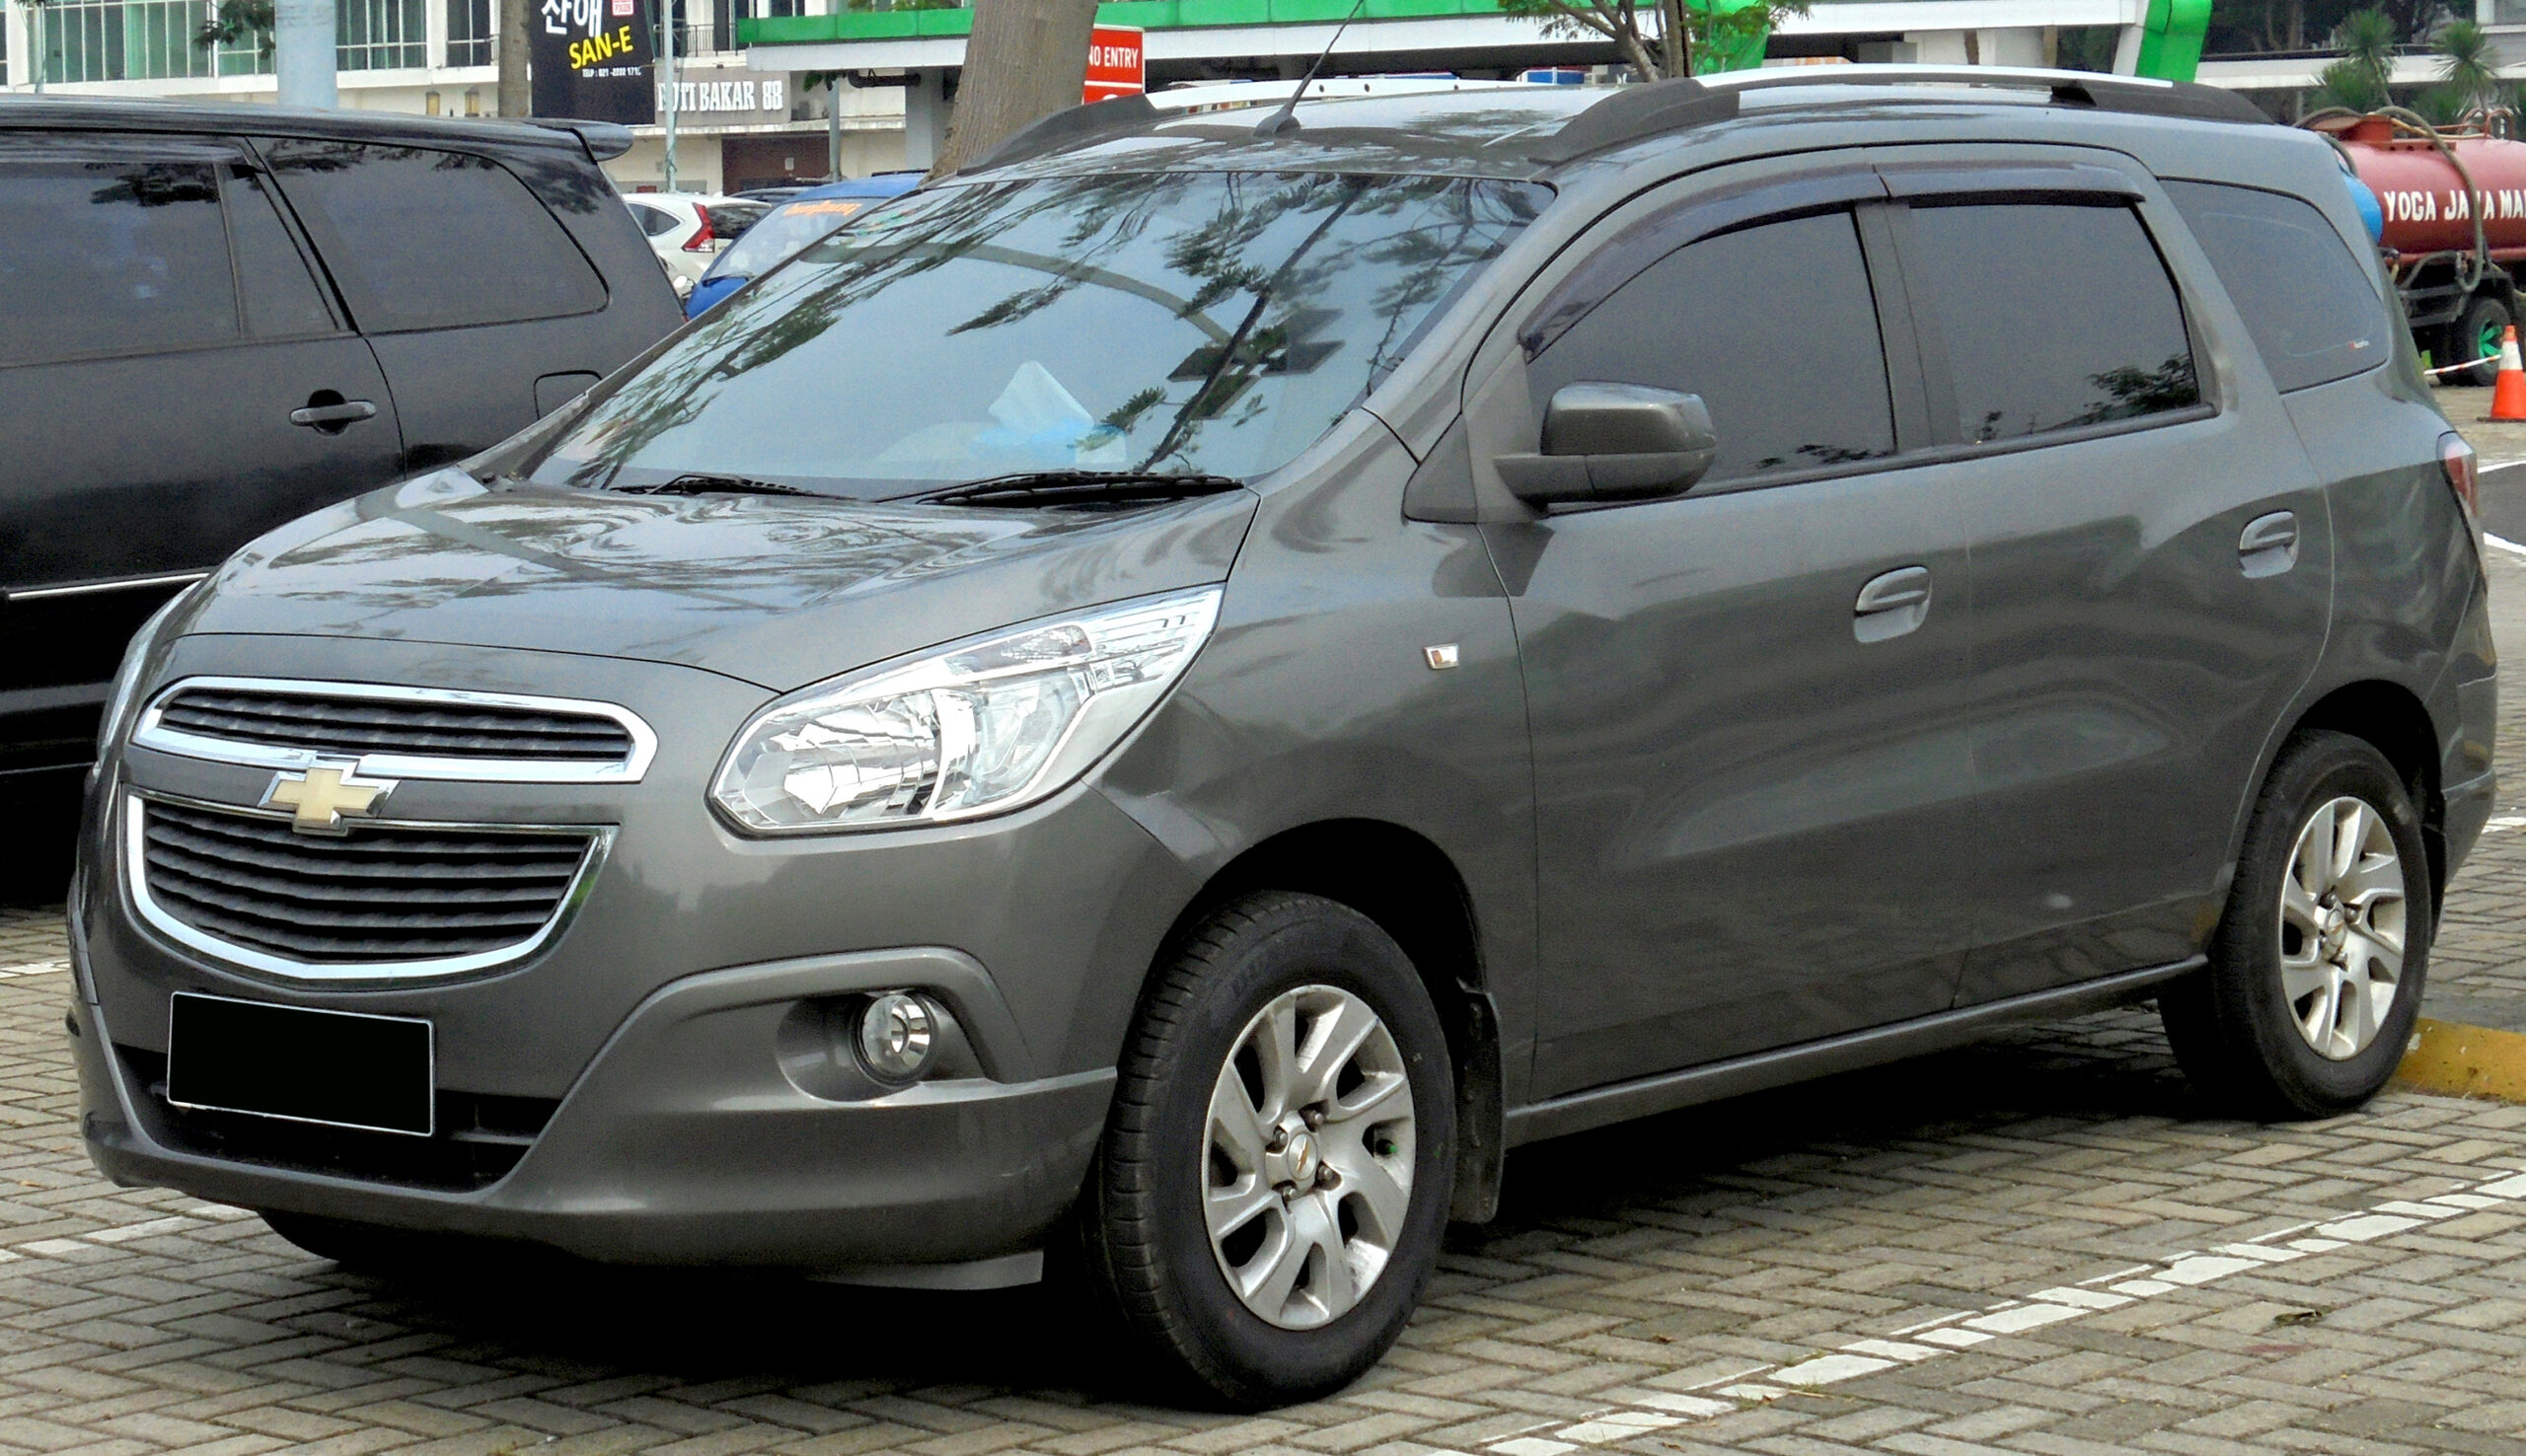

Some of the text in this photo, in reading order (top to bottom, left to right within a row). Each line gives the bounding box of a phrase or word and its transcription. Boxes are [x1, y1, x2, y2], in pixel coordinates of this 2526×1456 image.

[568, 25, 633, 69] SAN-E
[1104, 46, 1139, 68] ENTRY
[699, 81, 756, 111] BAKAR
[762, 80, 783, 110] 88
[2383, 190, 2436, 222] YOGA
[2498, 189, 2526, 219] MA
